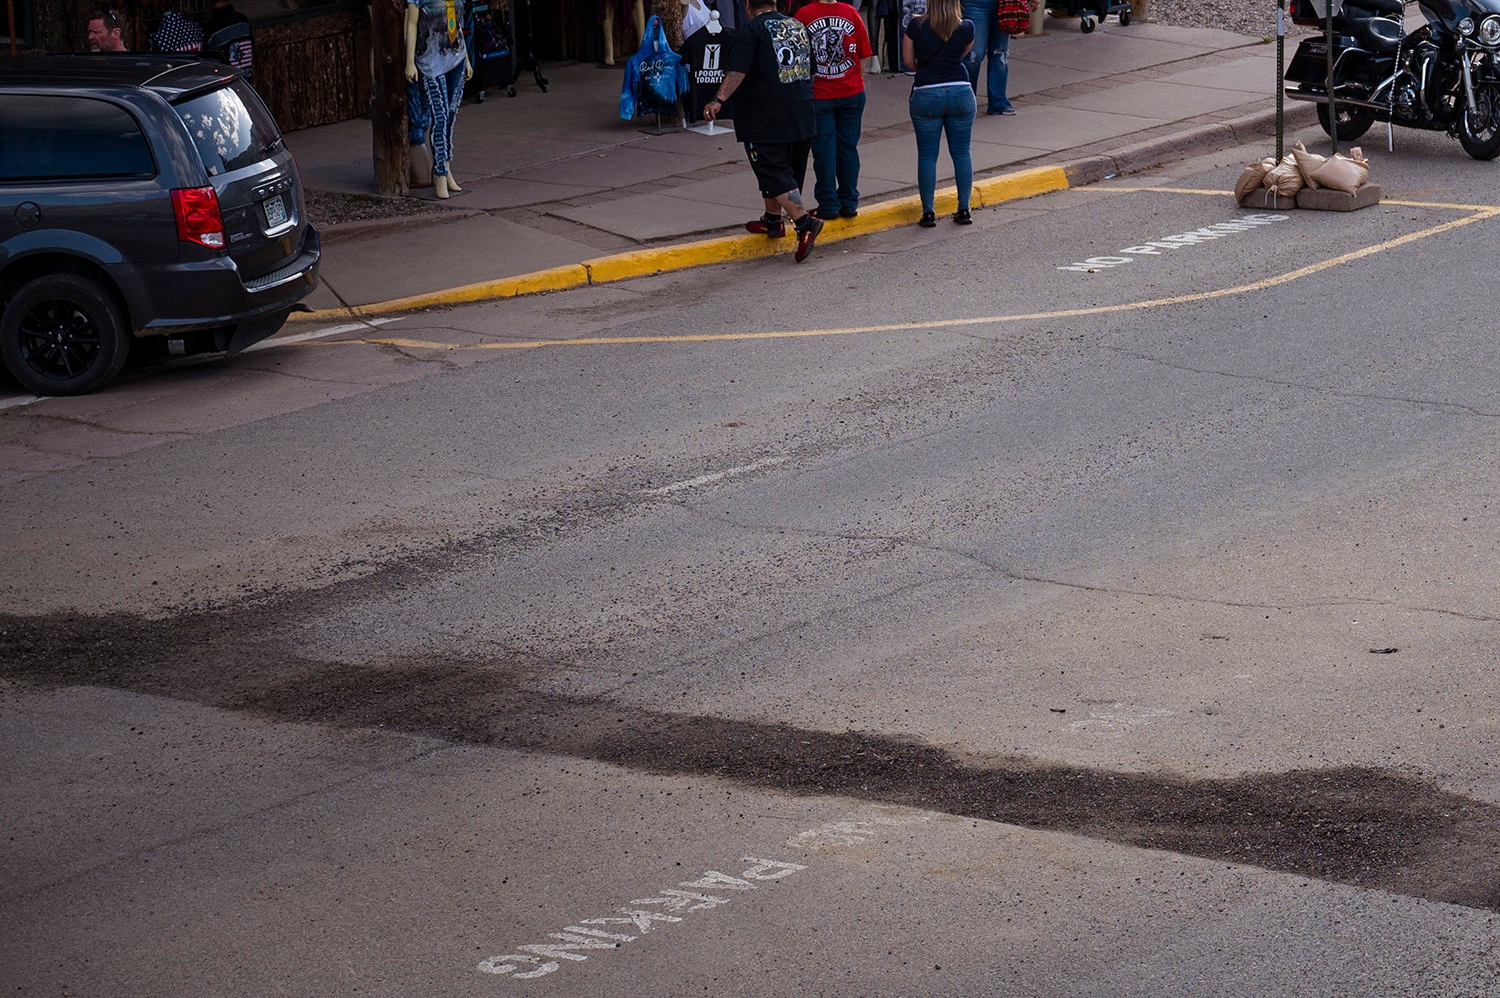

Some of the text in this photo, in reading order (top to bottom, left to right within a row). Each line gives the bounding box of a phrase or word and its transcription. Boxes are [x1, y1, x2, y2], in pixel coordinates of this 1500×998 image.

[829, 17, 855, 34] RIVER
[1057, 213, 1290, 273] NO PARKING
